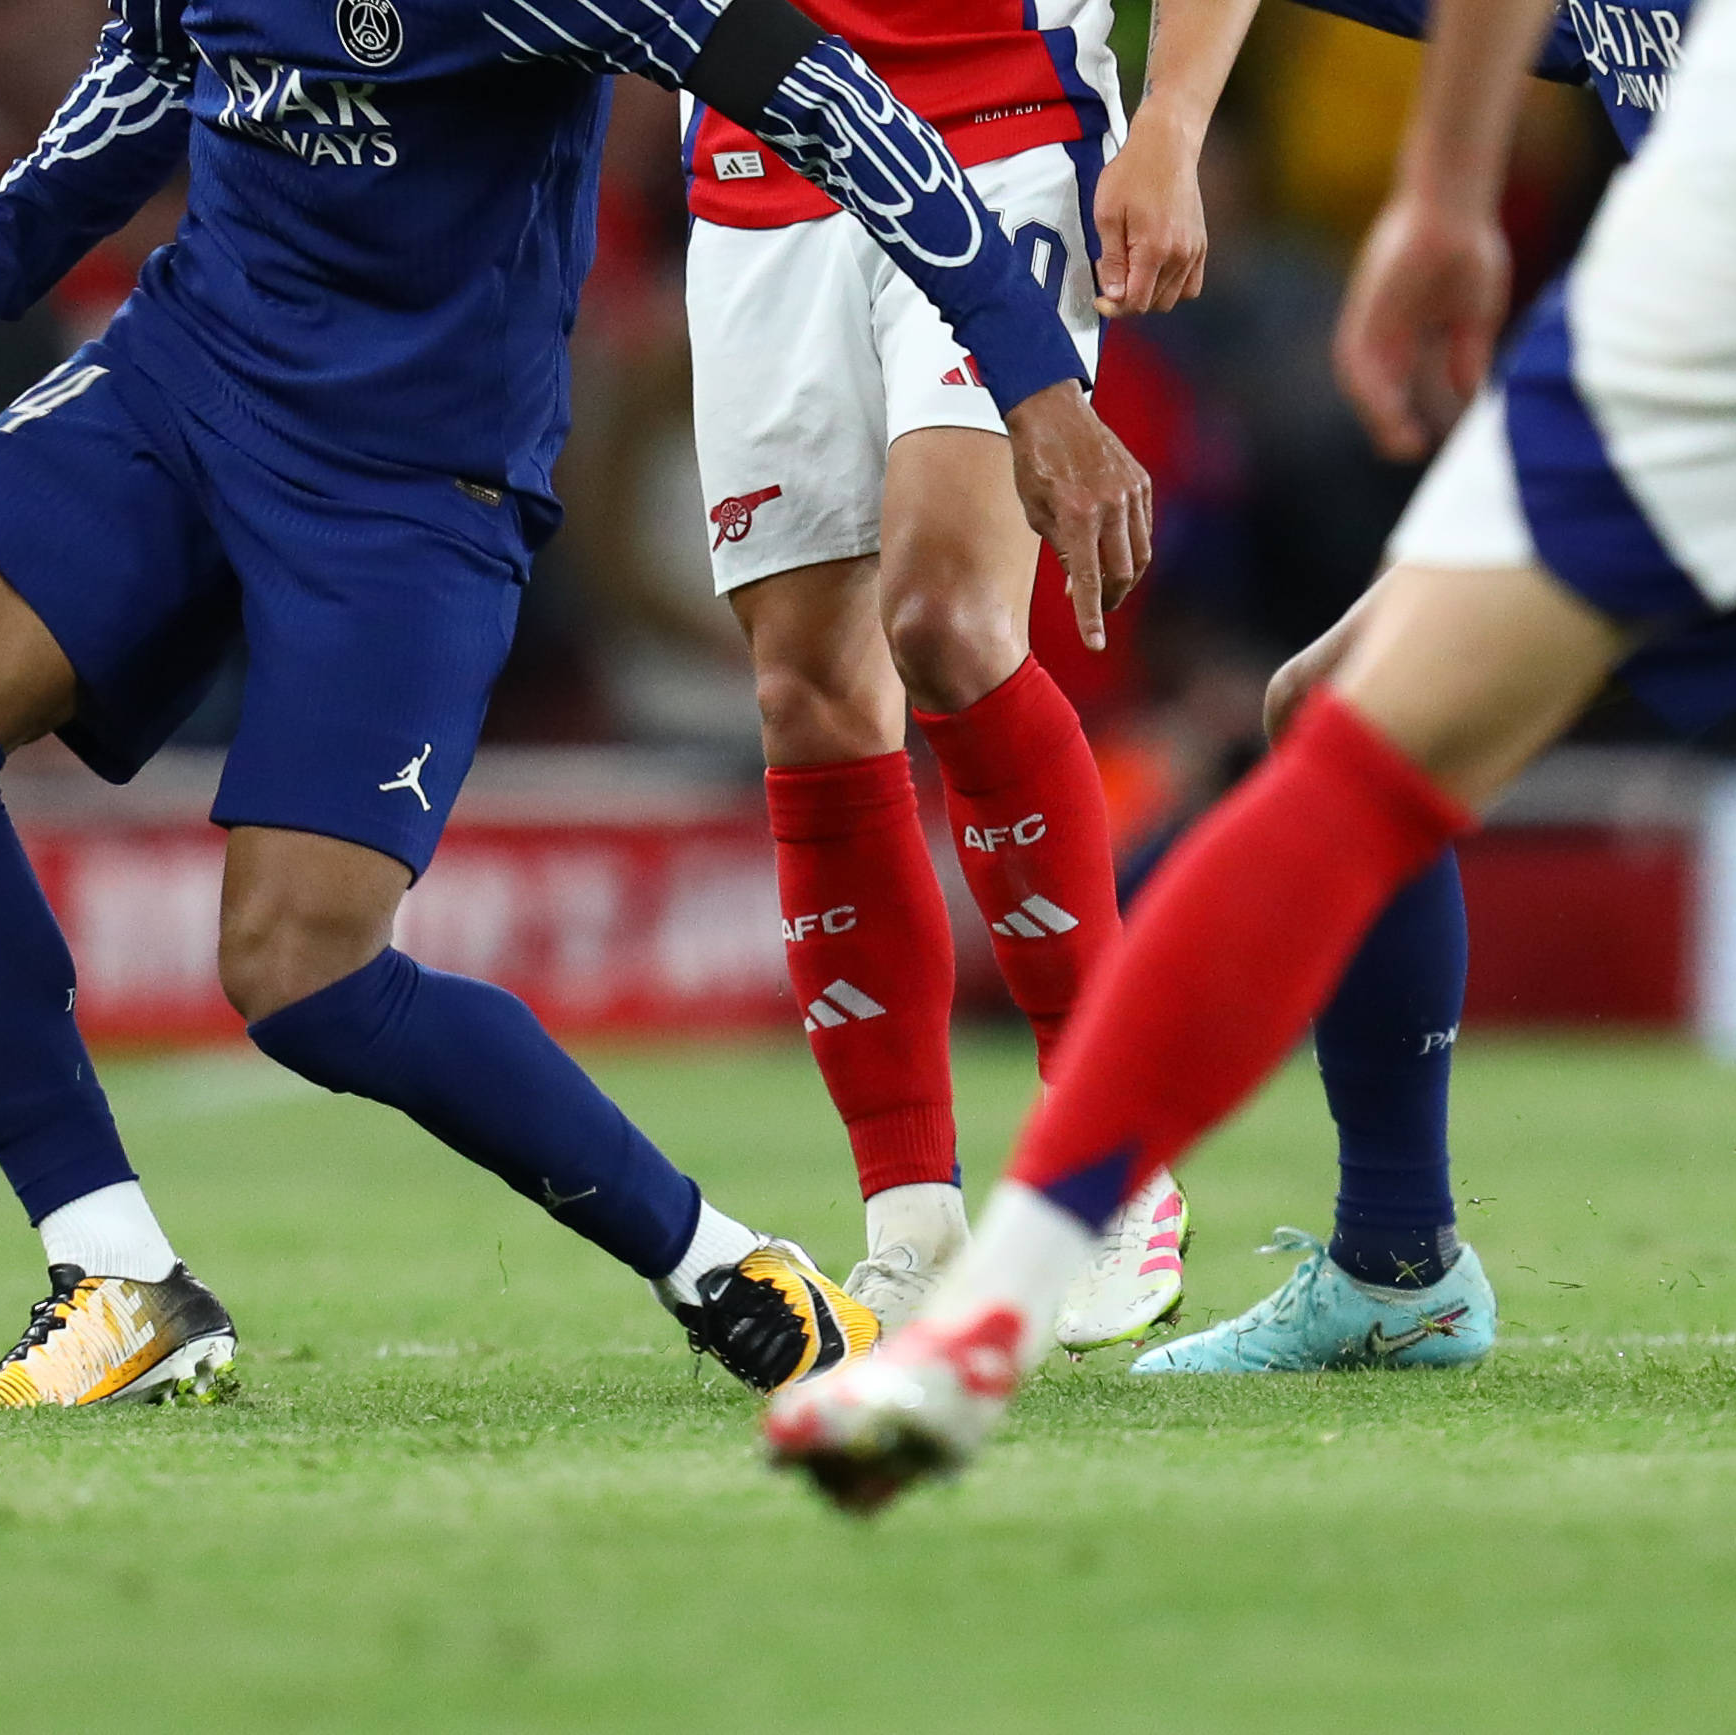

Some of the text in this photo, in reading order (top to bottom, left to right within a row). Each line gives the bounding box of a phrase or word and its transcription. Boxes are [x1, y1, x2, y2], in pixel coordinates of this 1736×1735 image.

[228, 55, 391, 127] ATAR
[964, 813, 1046, 852] AFC
[781, 905, 857, 942] AFC
